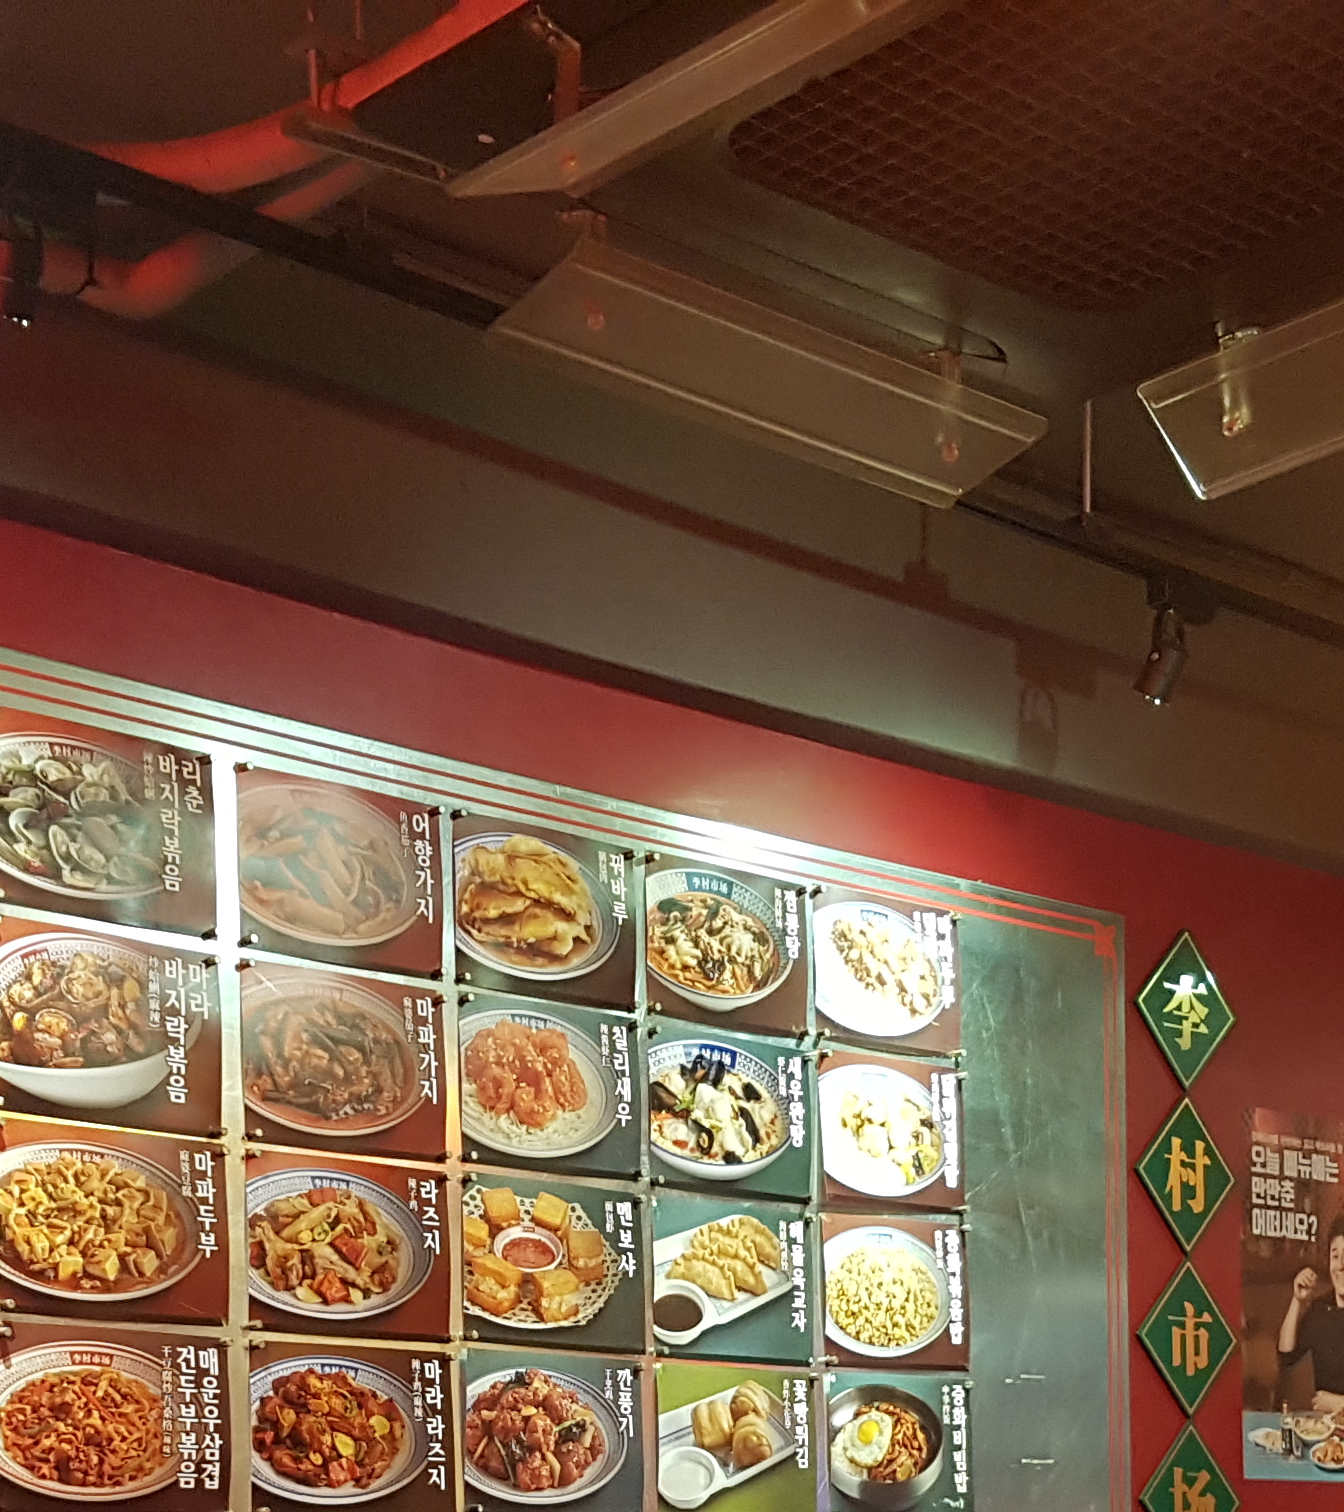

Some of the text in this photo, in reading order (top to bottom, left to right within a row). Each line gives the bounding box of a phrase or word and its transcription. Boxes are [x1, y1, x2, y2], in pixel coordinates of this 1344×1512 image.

[158, 752, 204, 893] 리춘 바지락볶음
[412, 812, 435, 924] 어향가지
[164, 956, 212, 1104] 마라 바지락볶음
[416, 996, 439, 1104] 마파가지
[612, 1026, 632, 1128] 칠리새우
[193, 1150, 219, 1258] 마파두부
[1251, 1144, 1280, 1176] 오늘
[419, 1180, 442, 1255] 라즈지
[616, 1201, 637, 1278] 멘보샤
[1251, 1207, 1318, 1243] 어떠세요?
[176, 1345, 223, 1489] 매운우삼겹 건두부볶음
[616, 1368, 634, 1438] 깐풍기
